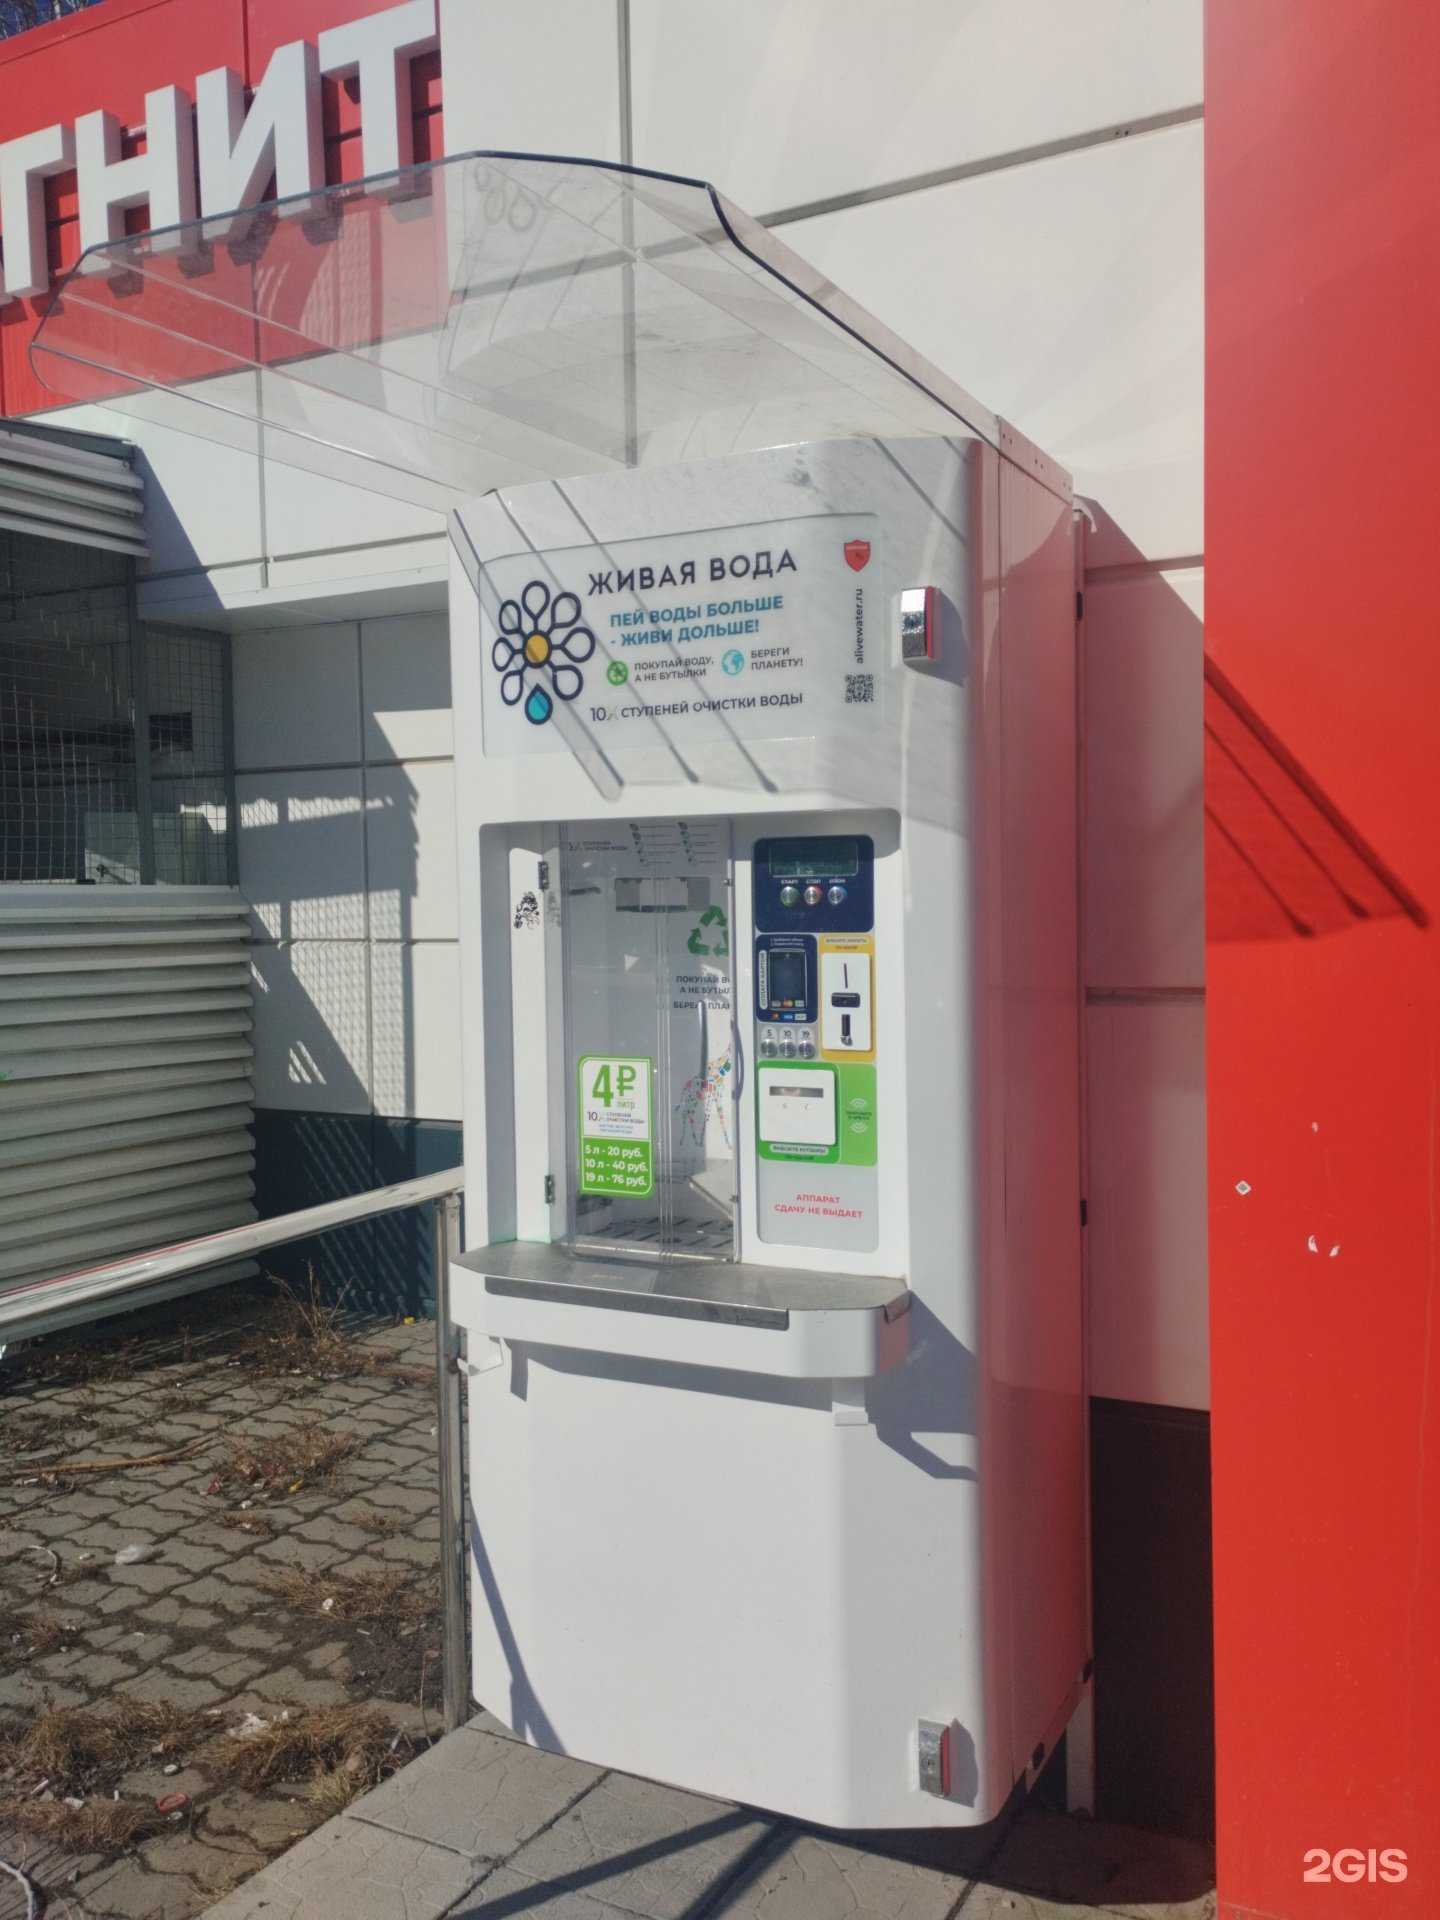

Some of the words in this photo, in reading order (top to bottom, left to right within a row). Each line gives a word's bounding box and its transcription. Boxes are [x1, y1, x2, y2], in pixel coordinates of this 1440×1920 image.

[588, 561, 696, 596] ЖИВАЯ
[709, 549, 798, 581] ВОДА
[610, 607, 644, 628] ПЕЙ
[650, 605, 701, 625] ВОДЫ
[707, 595, 784, 618] БОЛЬШЕ
[621, 628, 673, 648] ЖИВИ
[678, 619, 759, 644] ДОЛЬШЕ!
[855, 588, 864, 664] alivewater.ru
[751, 648, 790, 659] БЕРЕГИ
[634, 656, 683, 672] ПОКУПАЙ
[685, 656, 715, 668] ВОДУ,
[751, 658, 804, 671] ПЛАНЕТУ!
[634, 674, 642, 683] А
[644, 672, 657, 682] НЕ
[659, 668, 707, 680] БУТЫЛКИ
[621, 702, 689, 719] СТУПЕНЕЙ
[694, 697, 756, 713] ОЧИСТКИ
[760, 693, 803, 707] ВОДЫ
[585, 1144, 591, 1154] 5
[607, 1146, 620, 1156] 20
[622, 1147, 643, 1159] руб.
[585, 1158, 596, 1168] 10
[612, 1160, 625, 1170] 40
[627, 1162, 649, 1173] руб.
[612, 1174, 625, 1184] 76
[626, 1176, 647, 1187] руб.
[796, 1194, 840, 1204] АППАРАТ
[774, 1204, 806, 1214] СДАЧУ
[808, 1207, 820, 1215] НЕ
[823, 1208, 864, 1219] ВЫДАЕТ
